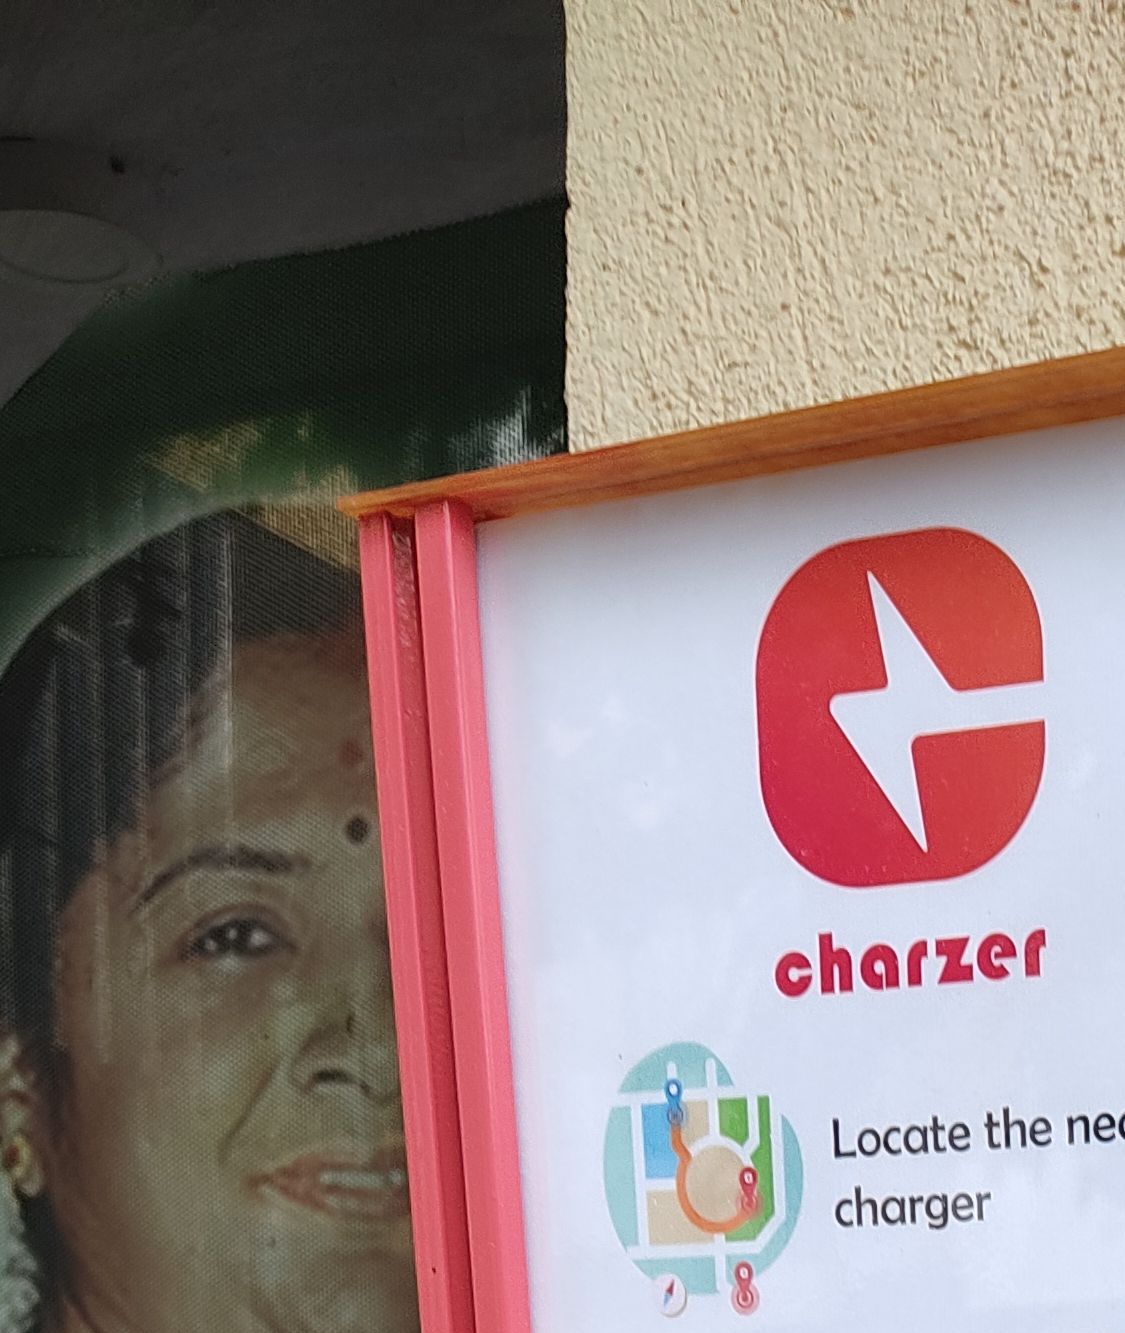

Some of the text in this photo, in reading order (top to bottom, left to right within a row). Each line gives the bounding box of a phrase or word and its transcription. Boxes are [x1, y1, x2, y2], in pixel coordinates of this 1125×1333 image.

[775, 929, 1046, 997] charzer
[831, 1115, 971, 1159] Locate
[985, 1107, 1052, 1149] the
[834, 1186, 991, 1229] charger
